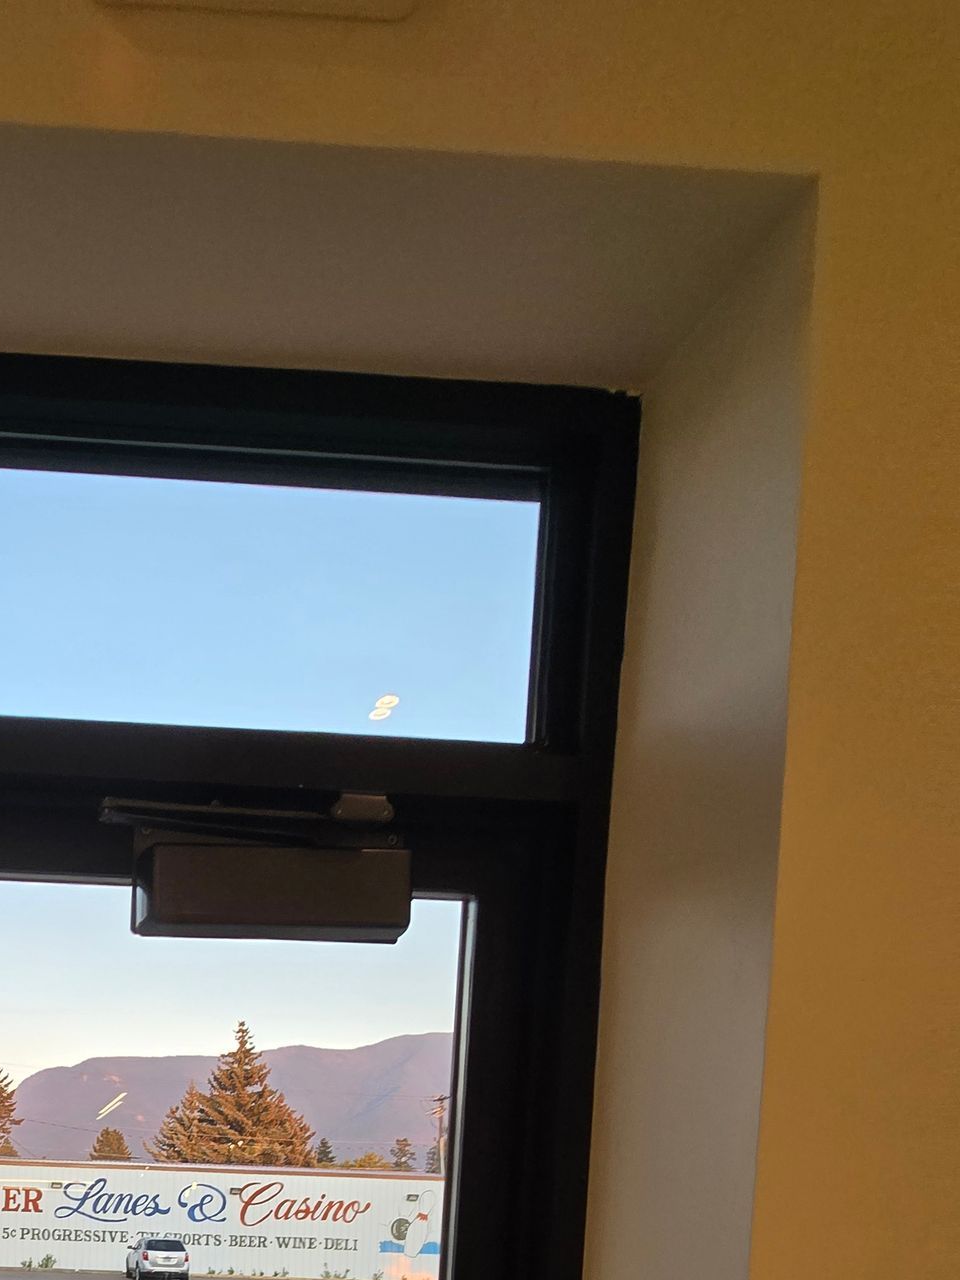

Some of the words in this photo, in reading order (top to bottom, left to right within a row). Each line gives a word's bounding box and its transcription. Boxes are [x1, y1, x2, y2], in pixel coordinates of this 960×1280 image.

[54, 1177, 171, 1222] Lanes
[177, 1183, 227, 1223] &
[239, 1181, 371, 1227] Casino
[20, 1228, 129, 1243] PROGRESSIVE
[229, 1234, 267, 1248] BEER
[276, 1236, 317, 1249] WINE
[324, 1238, 359, 1251] DELI
